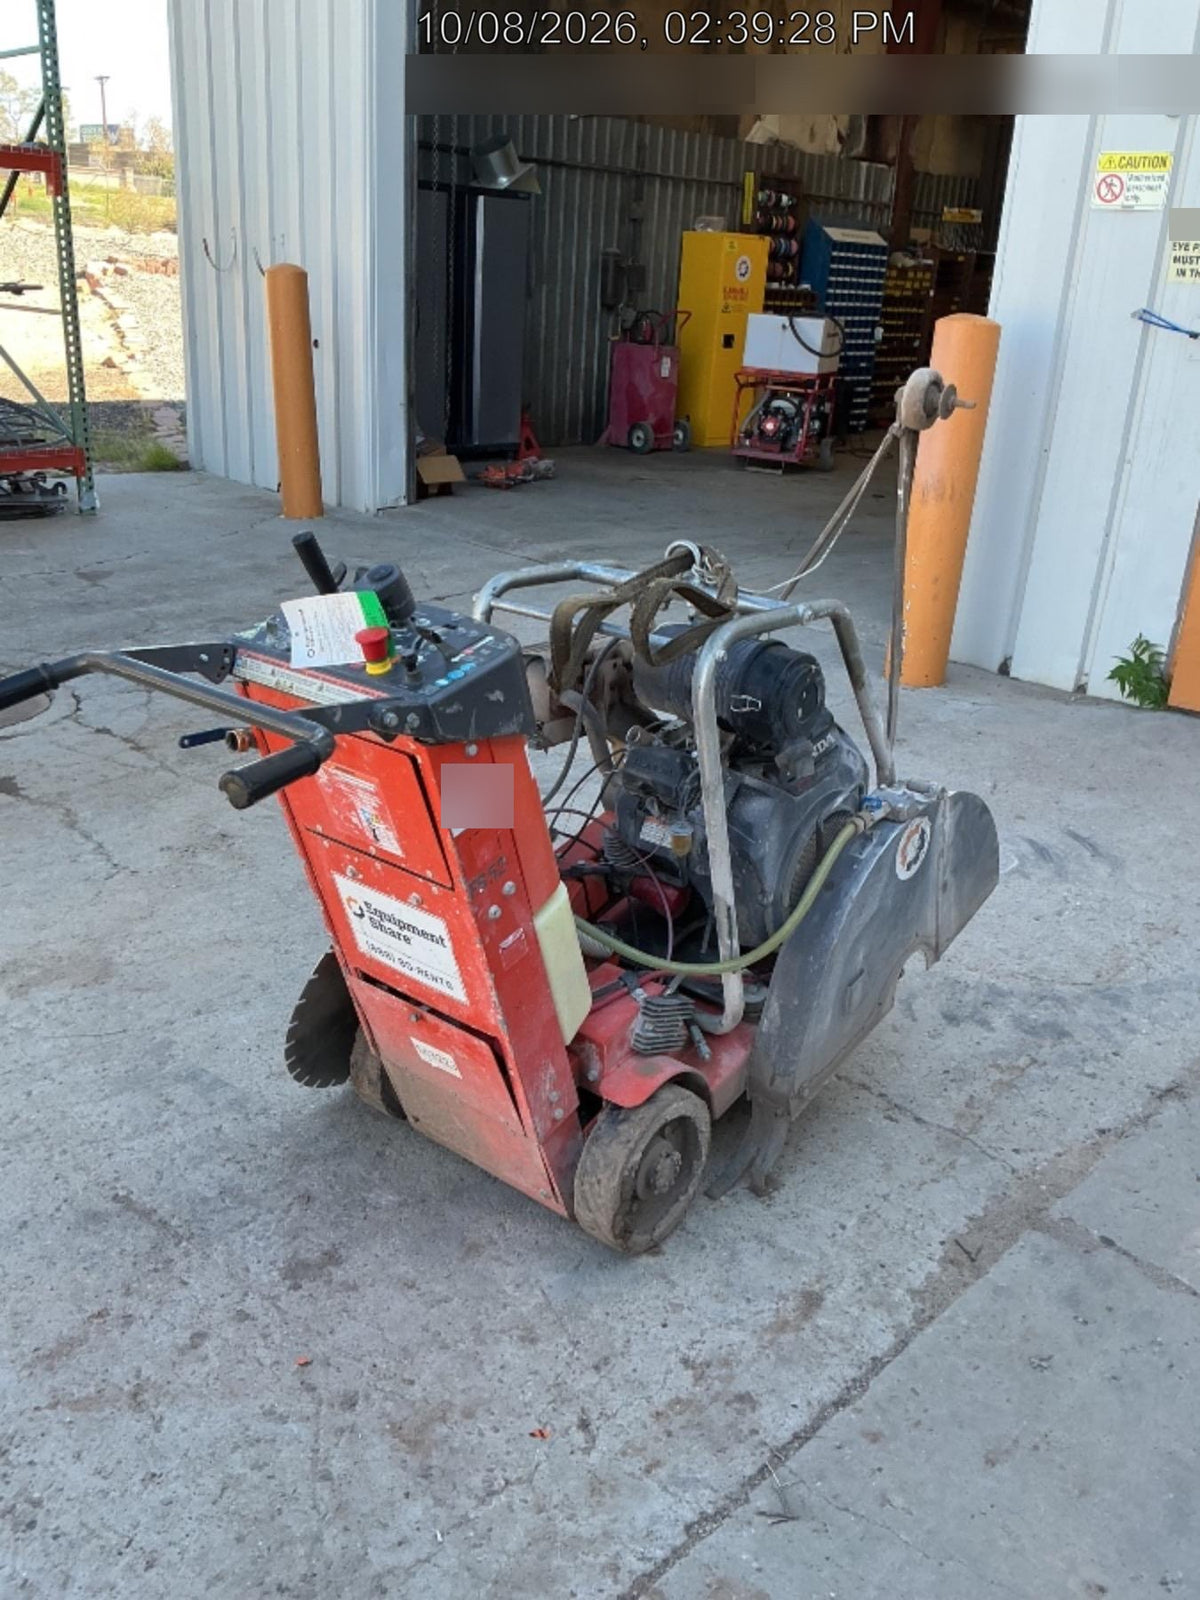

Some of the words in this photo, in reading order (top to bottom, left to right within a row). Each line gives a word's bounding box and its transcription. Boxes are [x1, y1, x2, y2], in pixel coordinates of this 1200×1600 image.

[1117, 155, 1168, 169] CAUTION
[1172, 242, 1190, 252] EYE
[1173, 256, 1200, 265] MUST
[1176, 268, 1186, 278] IN
[363, 901, 446, 948] Equipment
[368, 916, 411, 945] Share
